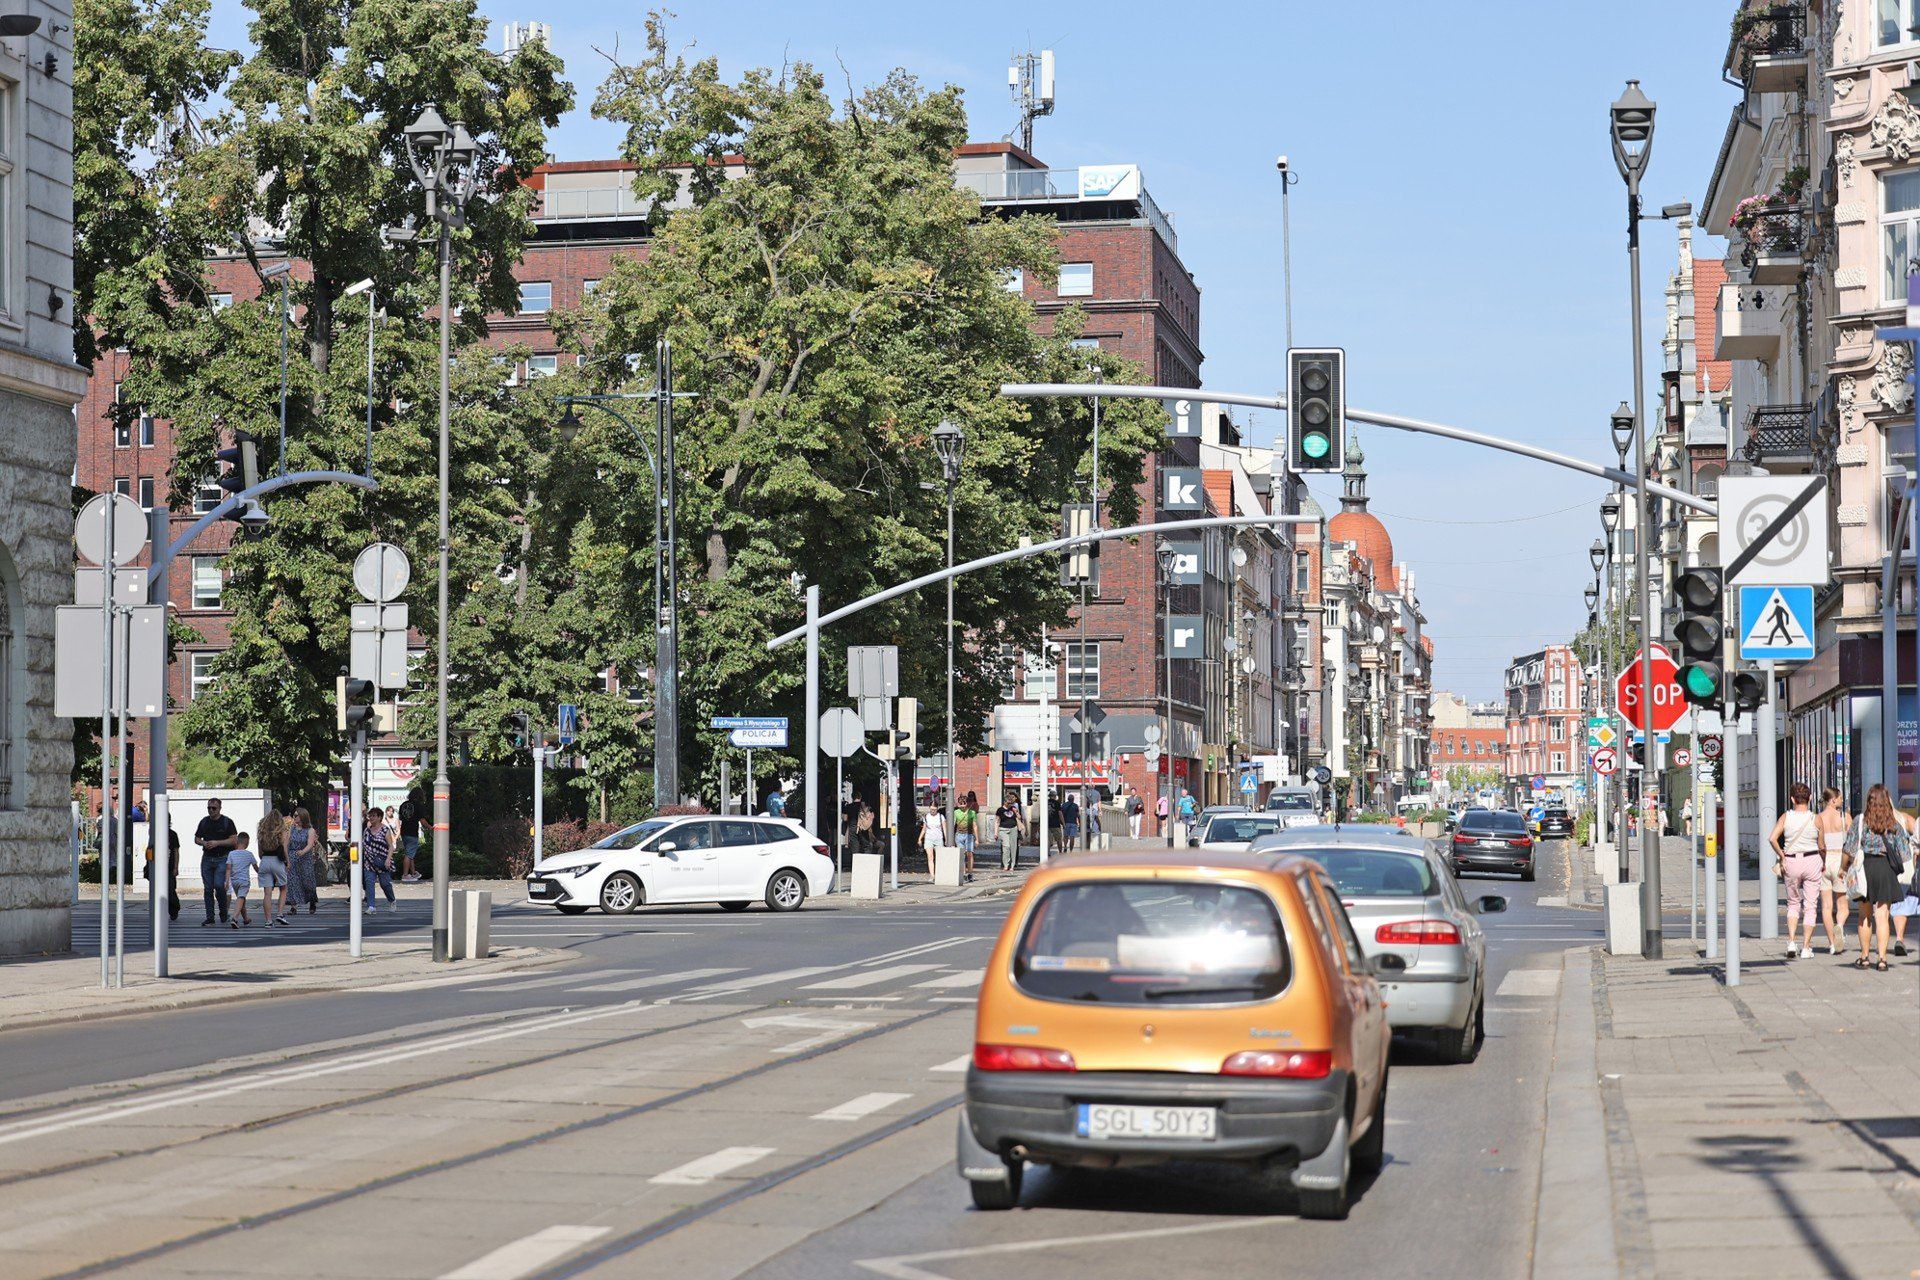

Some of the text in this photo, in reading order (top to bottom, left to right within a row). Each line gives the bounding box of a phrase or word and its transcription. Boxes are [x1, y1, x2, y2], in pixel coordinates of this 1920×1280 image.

[1084, 173, 1119, 190] SAP
[1625, 683, 1683, 706] SOP
[742, 730, 777, 738] POLICJA
[1093, 1108, 1210, 1134] SGL 50Y3
